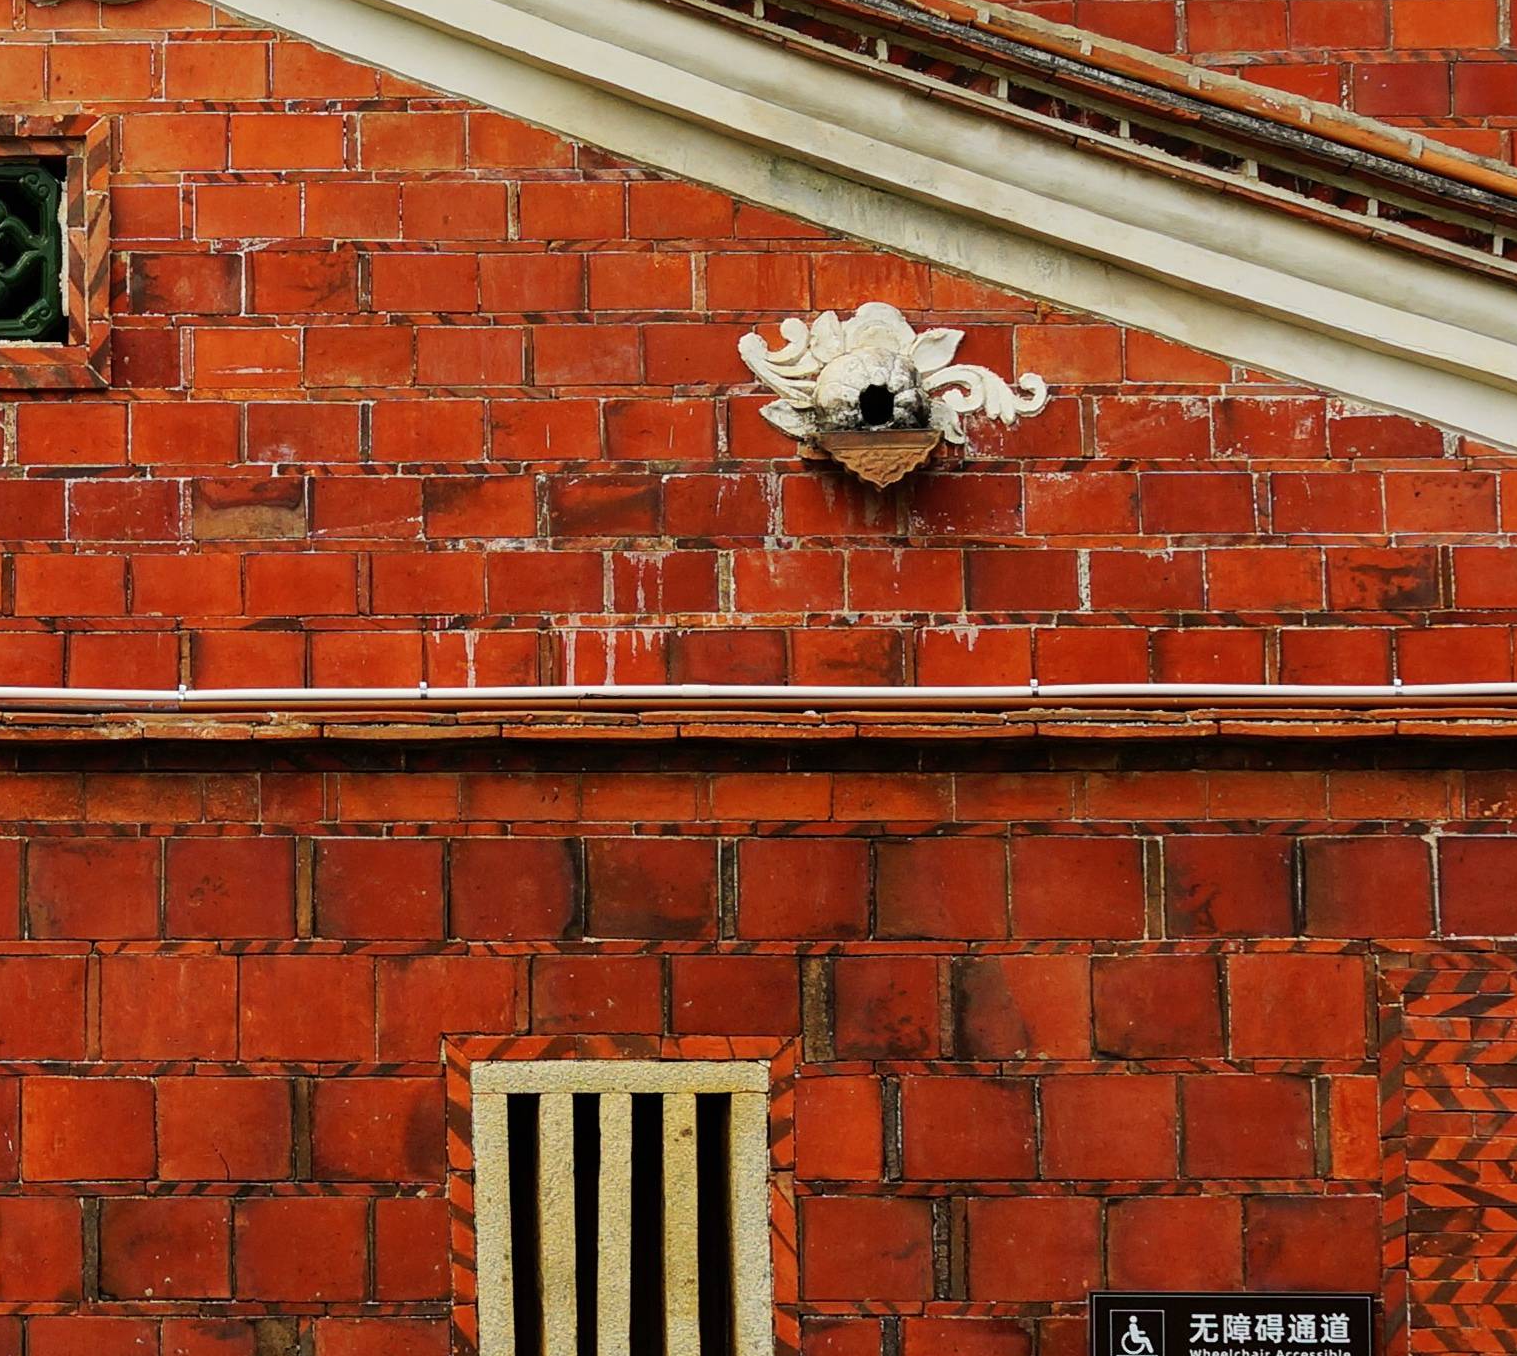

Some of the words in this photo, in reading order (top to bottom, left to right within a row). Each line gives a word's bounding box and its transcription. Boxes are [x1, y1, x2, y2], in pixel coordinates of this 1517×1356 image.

[1189, 1312, 1351, 1343] 无障碍通道
